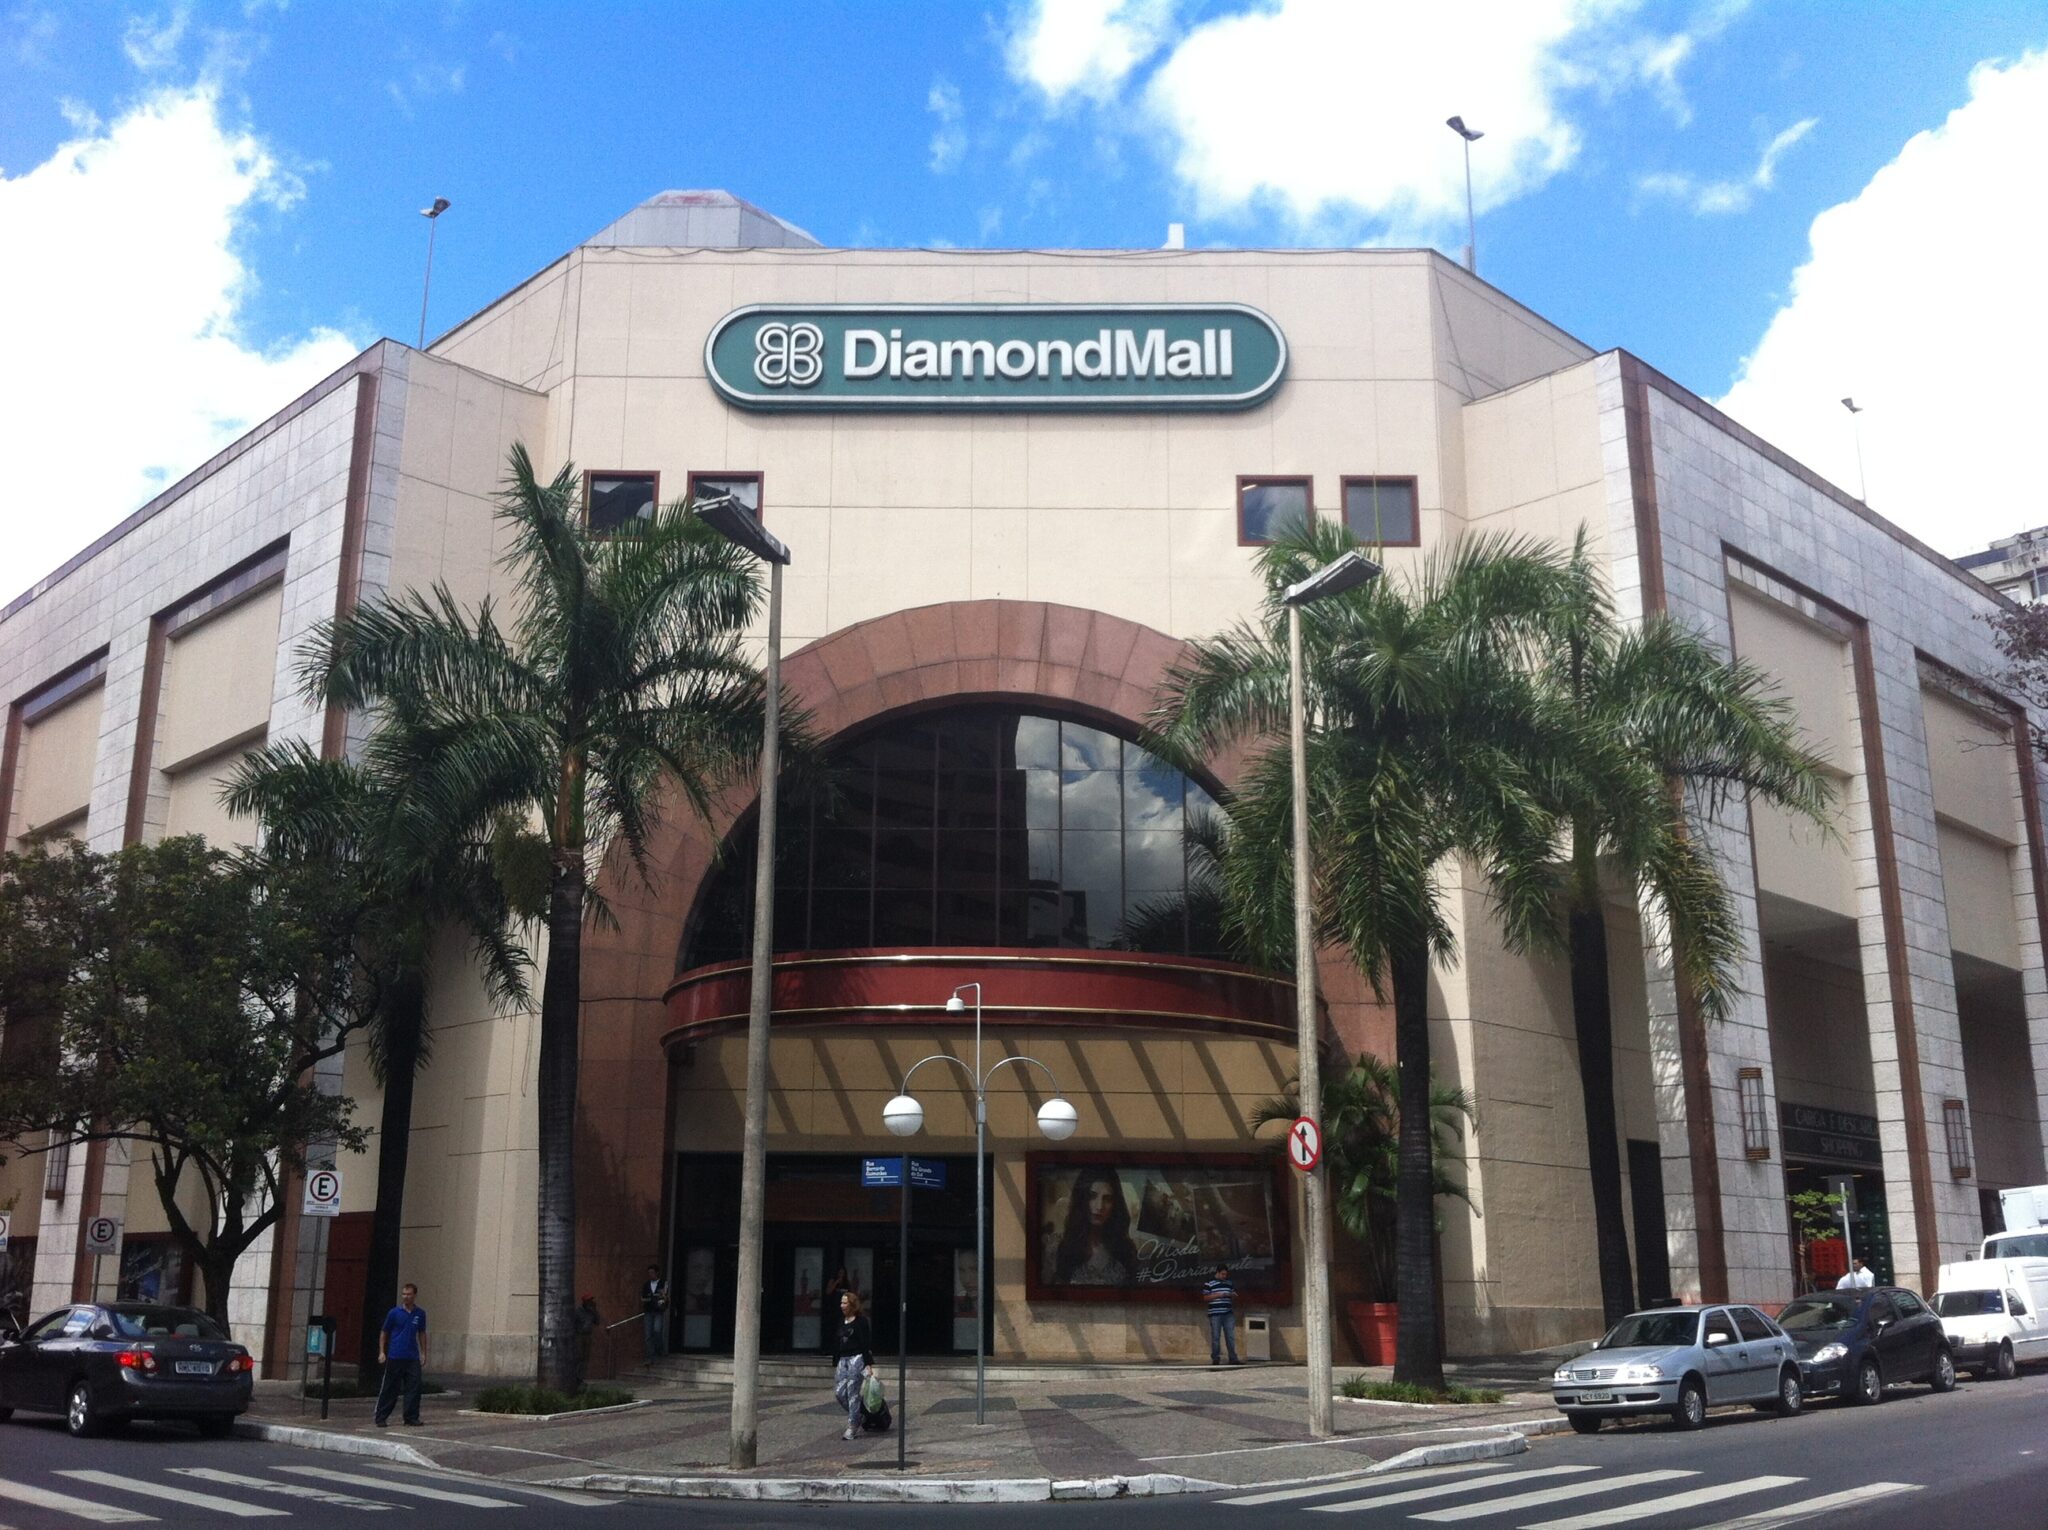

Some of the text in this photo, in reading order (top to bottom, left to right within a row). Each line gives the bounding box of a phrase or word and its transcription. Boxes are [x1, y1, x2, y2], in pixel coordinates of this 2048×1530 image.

[843, 328, 1233, 379] DiamondMall
[318, 1177, 331, 1196] E
[97, 1223, 107, 1238] E
[1137, 1235, 1200, 1260] Moda
